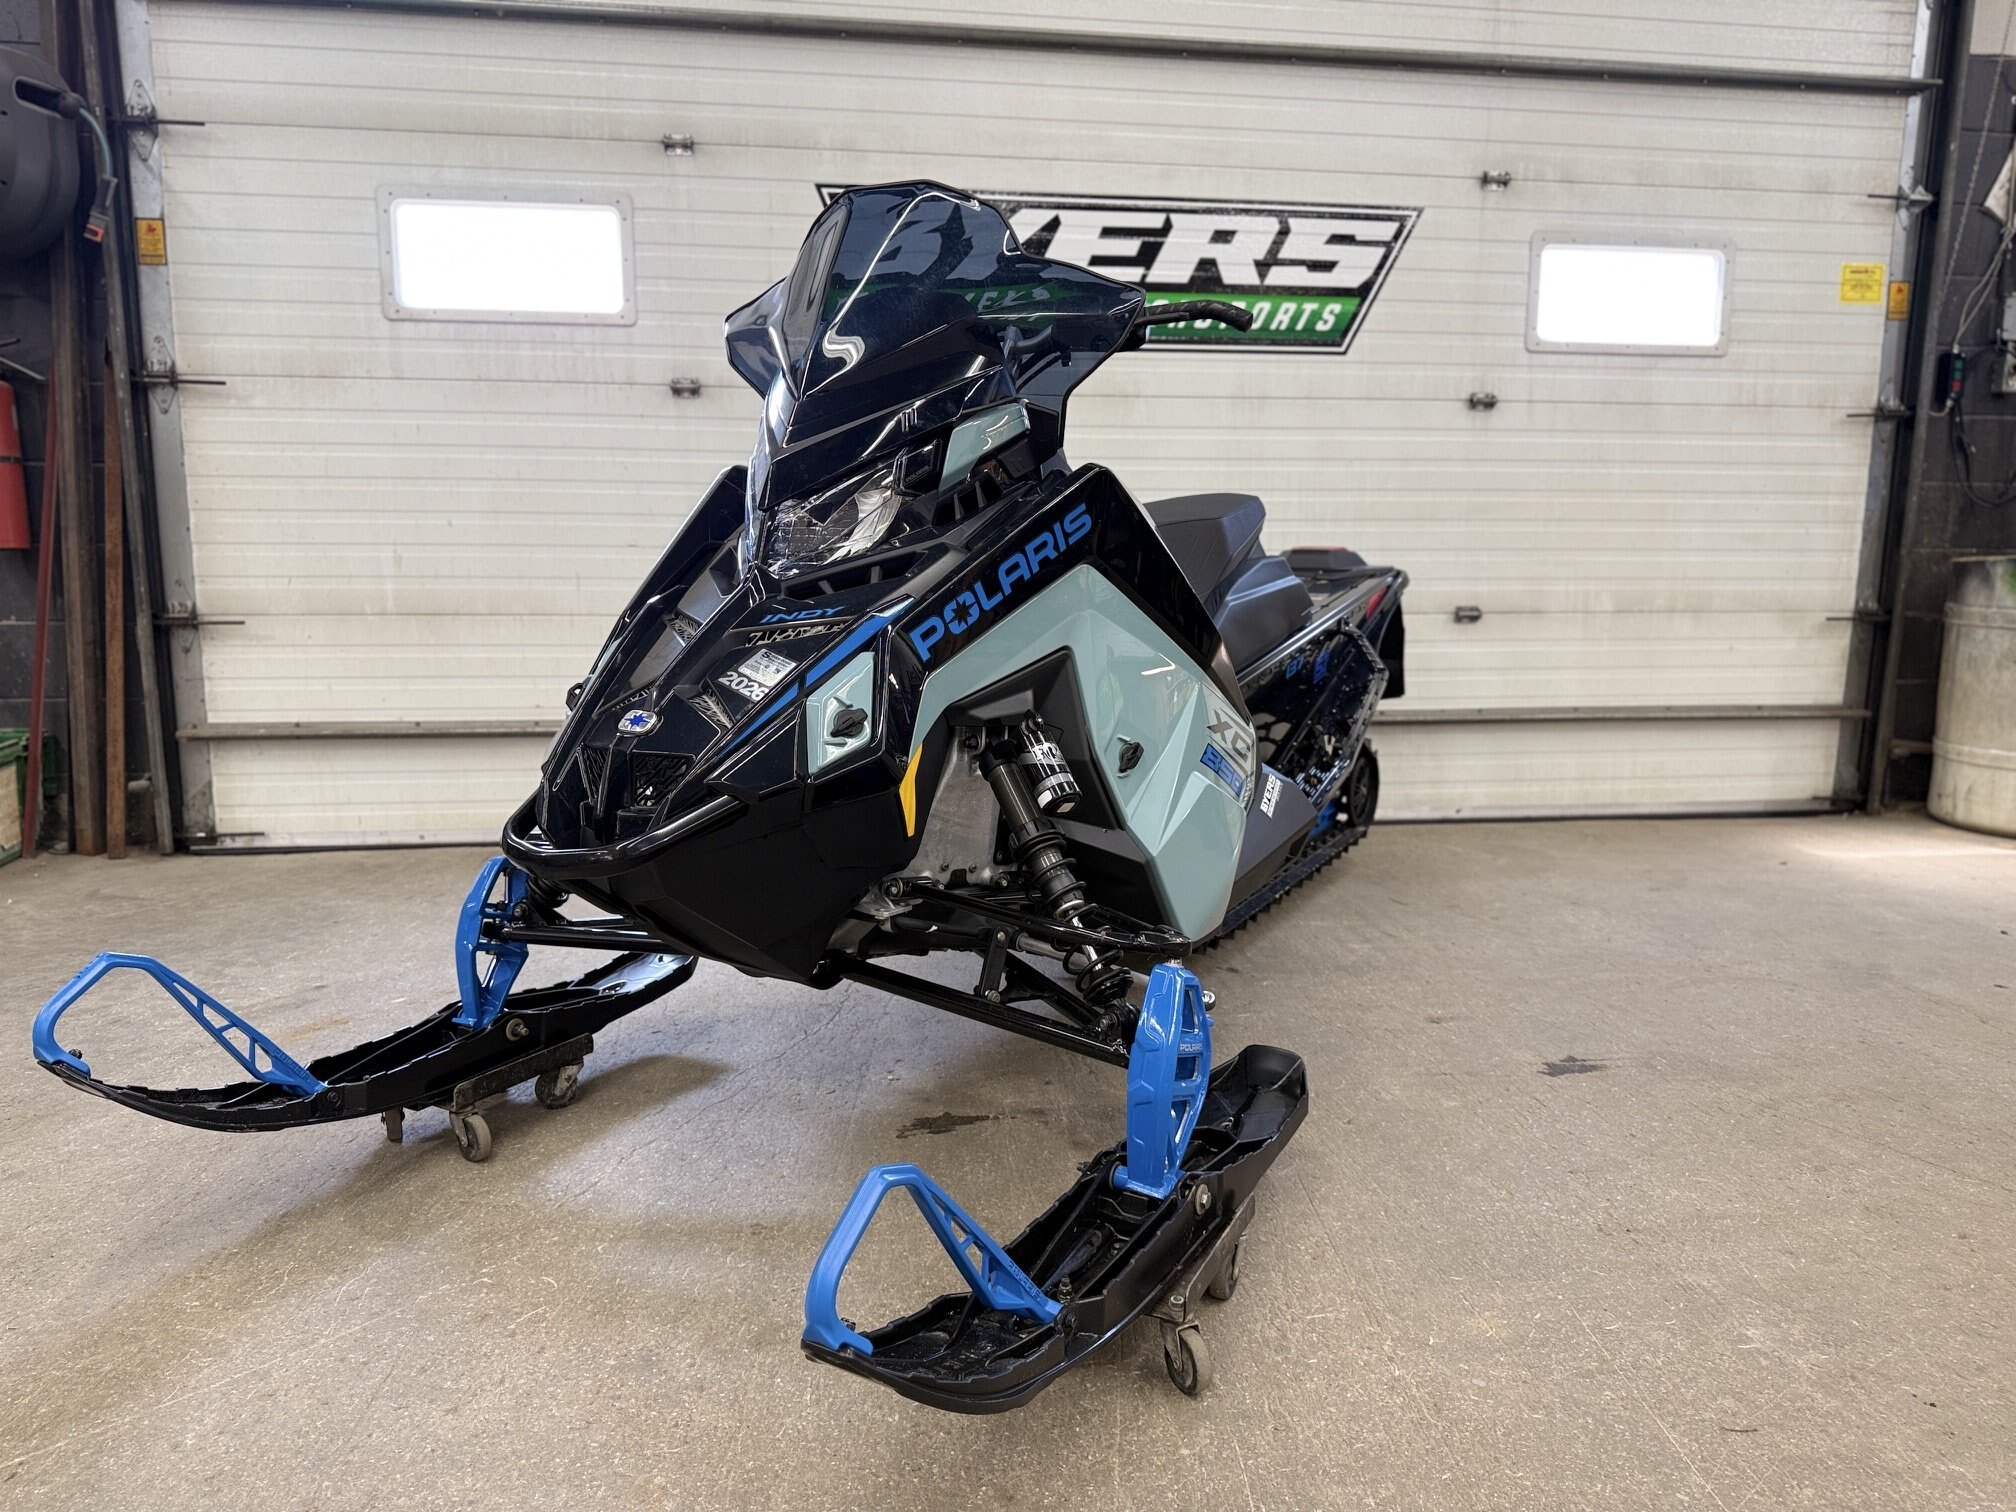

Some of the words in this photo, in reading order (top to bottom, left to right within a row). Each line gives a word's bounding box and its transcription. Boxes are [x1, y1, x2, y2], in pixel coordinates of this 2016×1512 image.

[909, 502, 1092, 662] POLARIS
[760, 605, 847, 623] INDY
[718, 671, 770, 701] 2026
[1200, 743, 1245, 798] 850
[1260, 773, 1277, 813] BYERS
